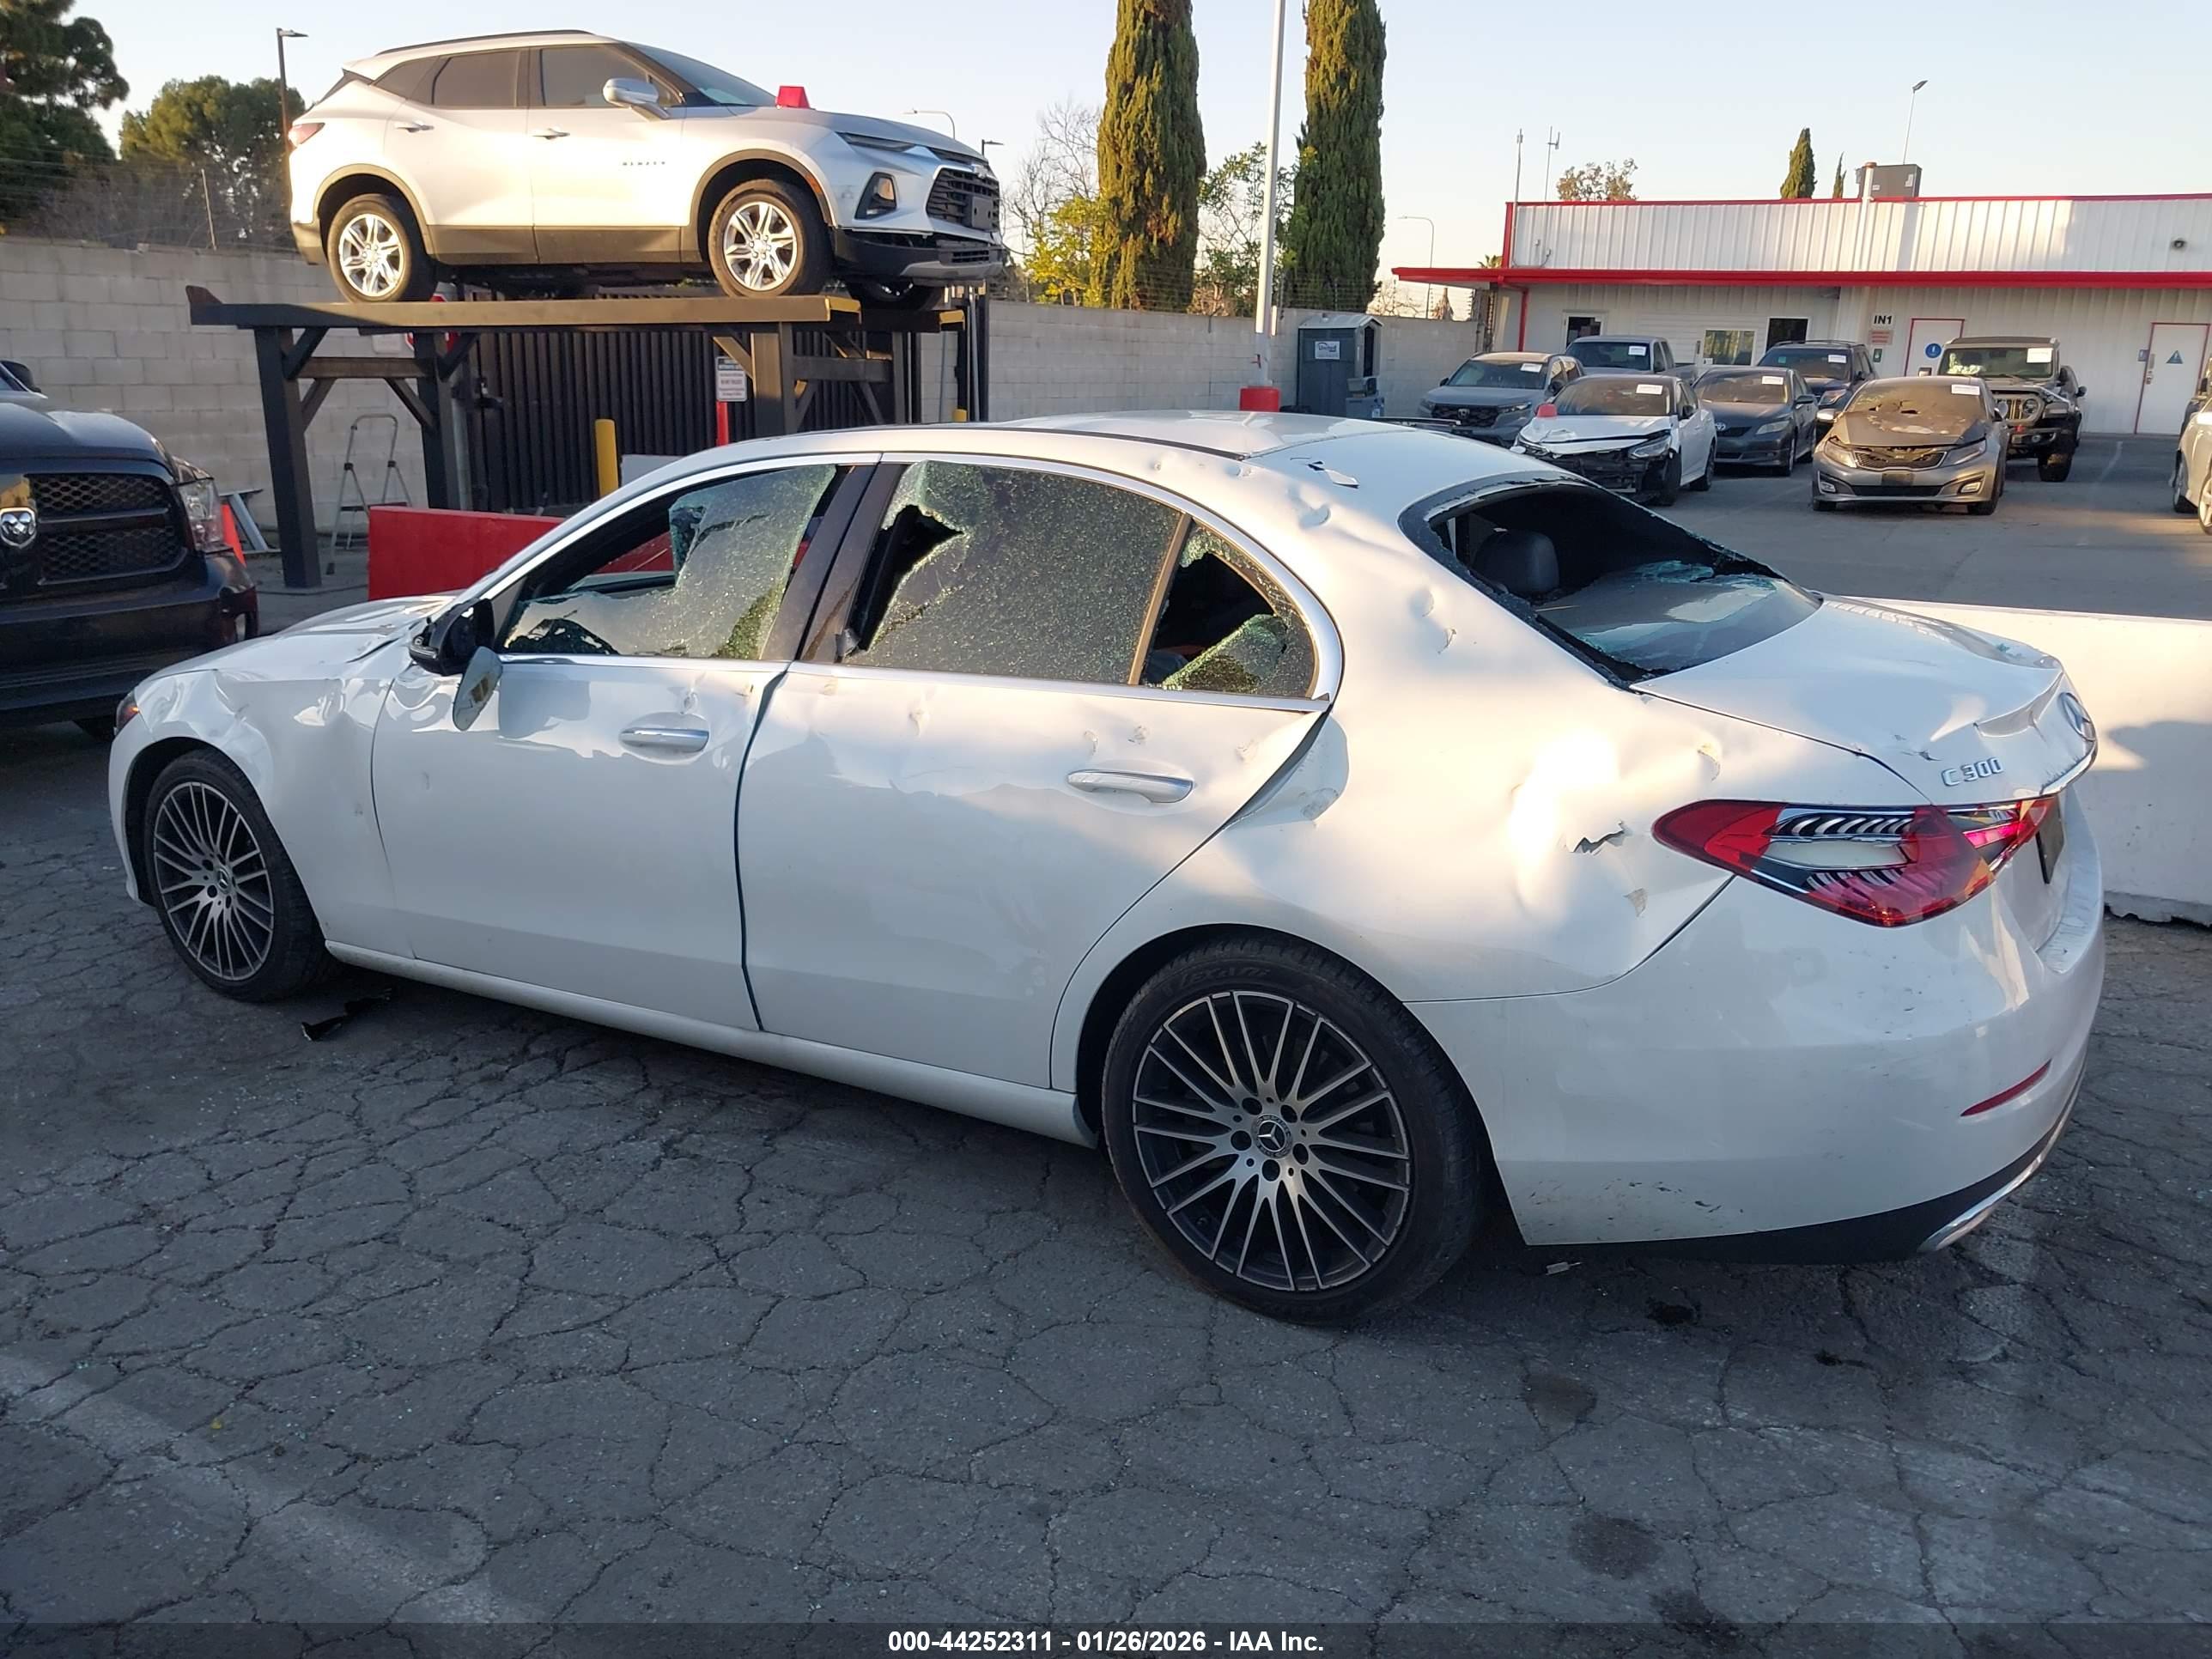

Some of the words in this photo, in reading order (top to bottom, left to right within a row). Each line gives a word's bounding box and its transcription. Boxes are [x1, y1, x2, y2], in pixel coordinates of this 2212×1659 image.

[1874, 315, 1893, 325] IN1
[1942, 769, 1961, 787] C
[1960, 757, 2004, 781] 300
